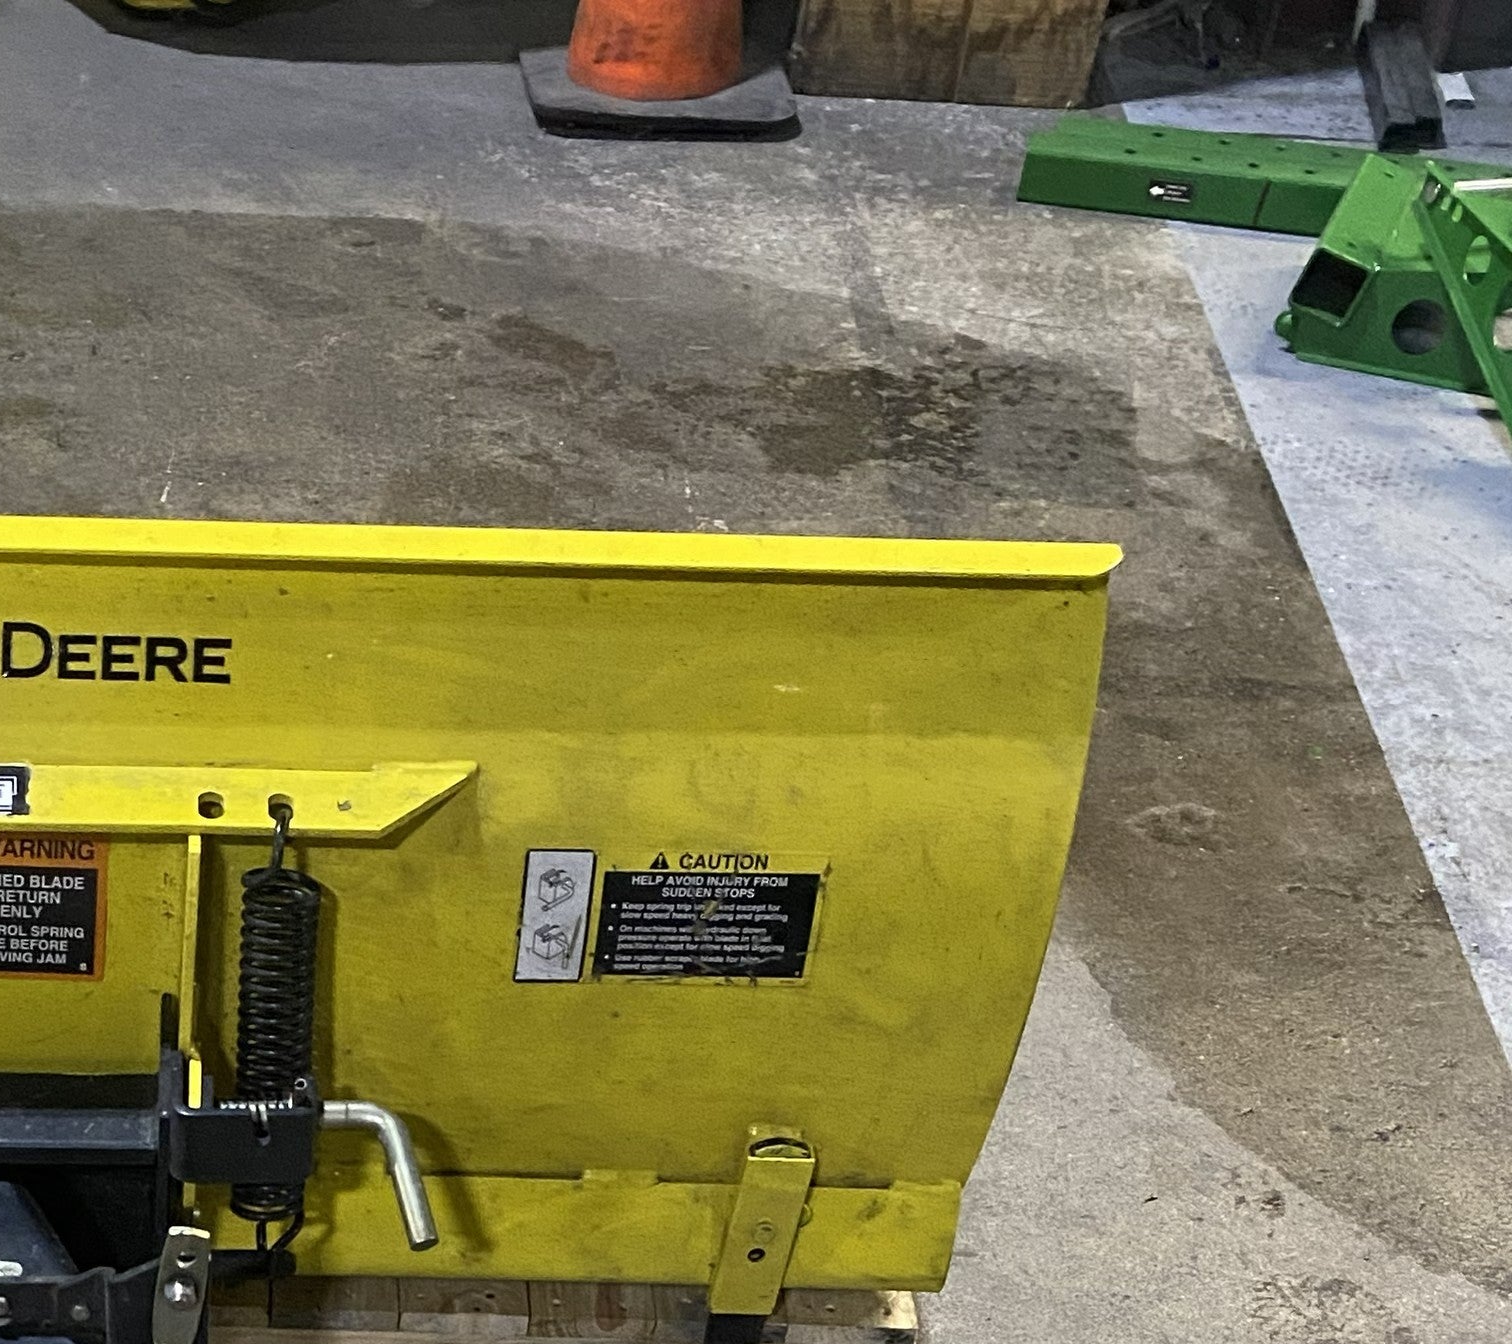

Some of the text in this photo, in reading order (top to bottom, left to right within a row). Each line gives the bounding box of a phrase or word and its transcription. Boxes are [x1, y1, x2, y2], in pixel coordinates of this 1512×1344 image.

[1, 621, 234, 684] DEERE
[678, 853, 770, 871] CAUTION
[29, 875, 85, 890] BLADE
[631, 875, 789, 888] HELP AVOID INJURY FROM
[714, 888, 756, 899] STOPS
[621, 902, 645, 911] Keep
[30, 925, 85, 939] SPRING
[9, 938, 68, 952] BEFORE
[36, 953, 67, 964] JAM
